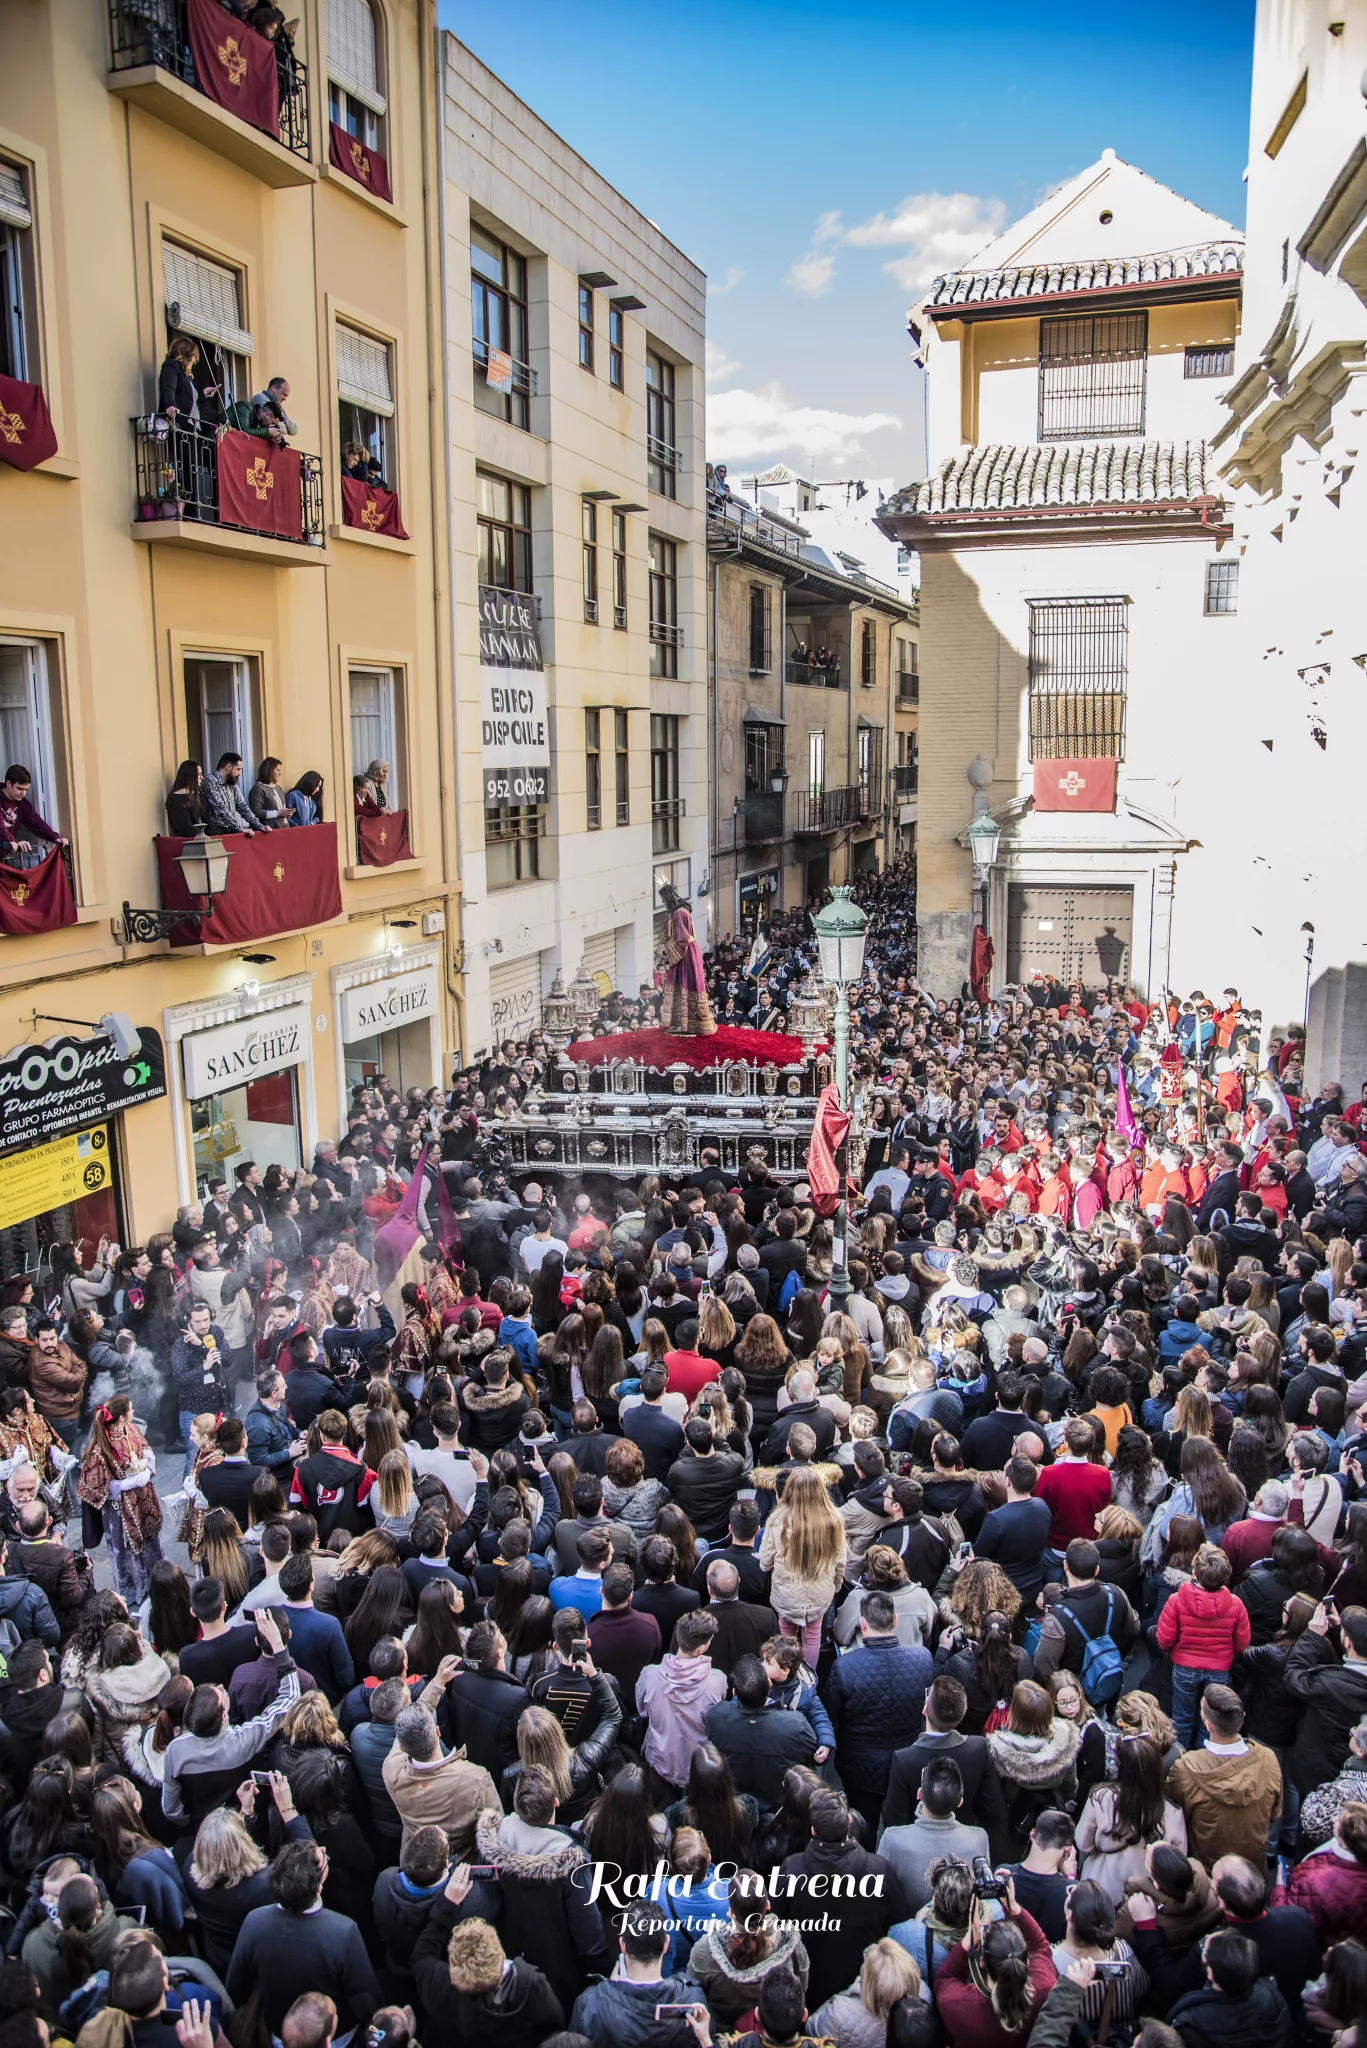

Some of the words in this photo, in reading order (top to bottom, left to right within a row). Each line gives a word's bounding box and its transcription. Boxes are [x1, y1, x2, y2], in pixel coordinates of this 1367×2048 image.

[487, 780, 510, 799] 952
[358, 989, 428, 1026] SANCHEZ
[207, 1031, 300, 1080] SANCHEZ
[3, 1078, 104, 1118] Puentezuelas
[3, 1114, 40, 1133] GRUPO
[42, 1092, 106, 1121] FARMAOPTICS
[6, 1128, 38, 1144] CONTACTO
[43, 1115, 78, 1132] OPTOMETRIA
[79, 1107, 102, 1121] INFANTIL
[106, 1092, 147, 1111] REHABILITACION
[147, 1086, 164, 1097] VISUAL
[86, 1167, 102, 1185] 58
